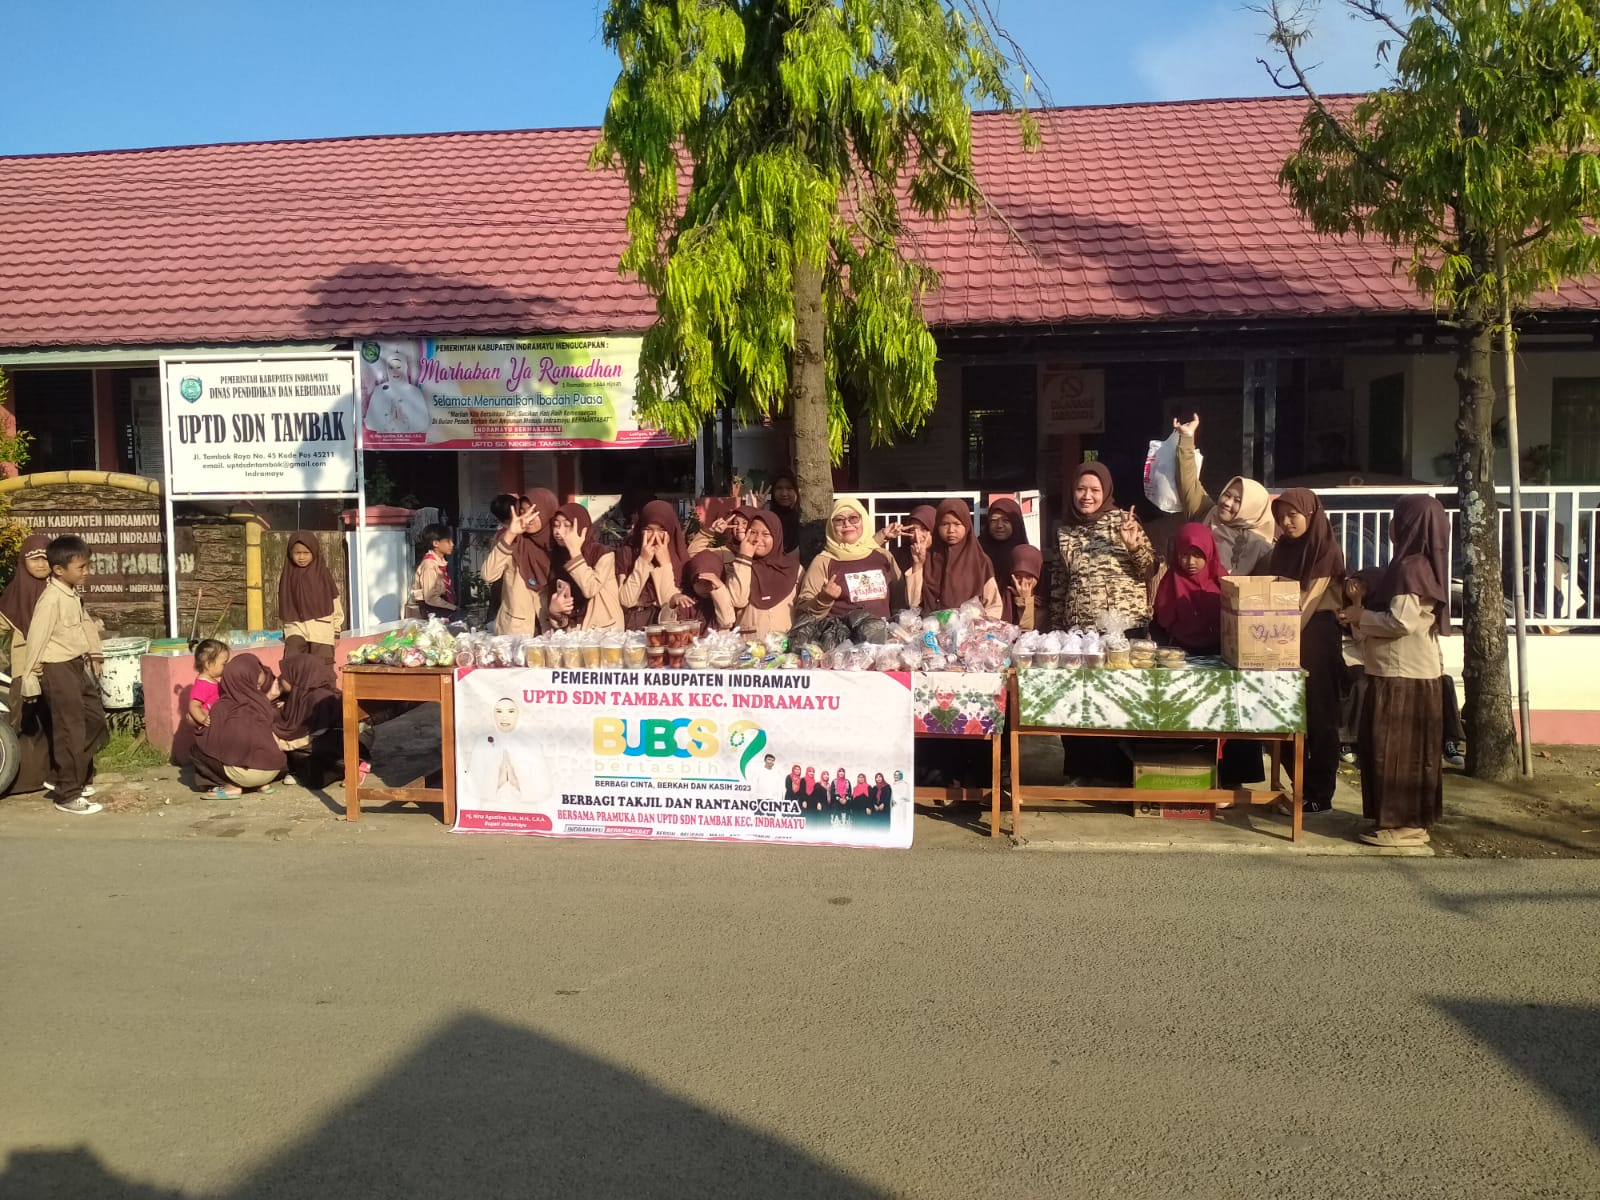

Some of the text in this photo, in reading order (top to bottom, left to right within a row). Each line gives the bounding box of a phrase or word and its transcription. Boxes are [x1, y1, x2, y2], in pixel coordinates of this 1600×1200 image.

[436, 344, 475, 352] PEMERINTAH
[478, 343, 514, 351] KABUPATEN
[516, 342, 554, 350] INDRAMAYU
[556, 341, 605, 350] MENGUCAPKAN
[220, 373, 328, 384] PEMERINTAH KABUPATEN INDRAMAYU
[418, 356, 622, 392] Marhaban Ya Ramadhan
[210, 384, 341, 399] DINAS PENDIDIKAN DAN KEBUDAYAAN
[432, 393, 603, 406] Selamat Menunaikan Ibadah Puasa
[178, 411, 346, 444] UPTD SDN TAMBAK
[234, 453, 250, 461] Raya
[252, 452, 266, 460] No.
[226, 461, 326, 470] uptdsdntambak@gmail.com
[245, 470, 284, 478] Indramayu
[48, 515, 102, 527] KABUPATEN
[104, 514, 160, 527] INDRAMAYU
[90, 584, 123, 592] PAOMAN
[552, 670, 810, 689] PEMERINTAH KABUPATEN INDRAMAYU
[522, 690, 840, 710] UPTD SDN TAMBAK KEC. INDRAMAYU
[594, 760, 718, 774] bertasbih
[594, 780, 628, 788] BERBAGI
[630, 781, 655, 789] CINTA,
[658, 782, 688, 790] BERKAH
[690, 782, 708, 790] DAN
[734, 784, 752, 792] 2023
[562, 794, 800, 812] BERBAGI TAKJIL DAN RANTANG CINTA
[558, 809, 805, 830] BERSAMA PRAMUKA DAN UPTD SDN TAMBAK KEC. INDRAMAYU
